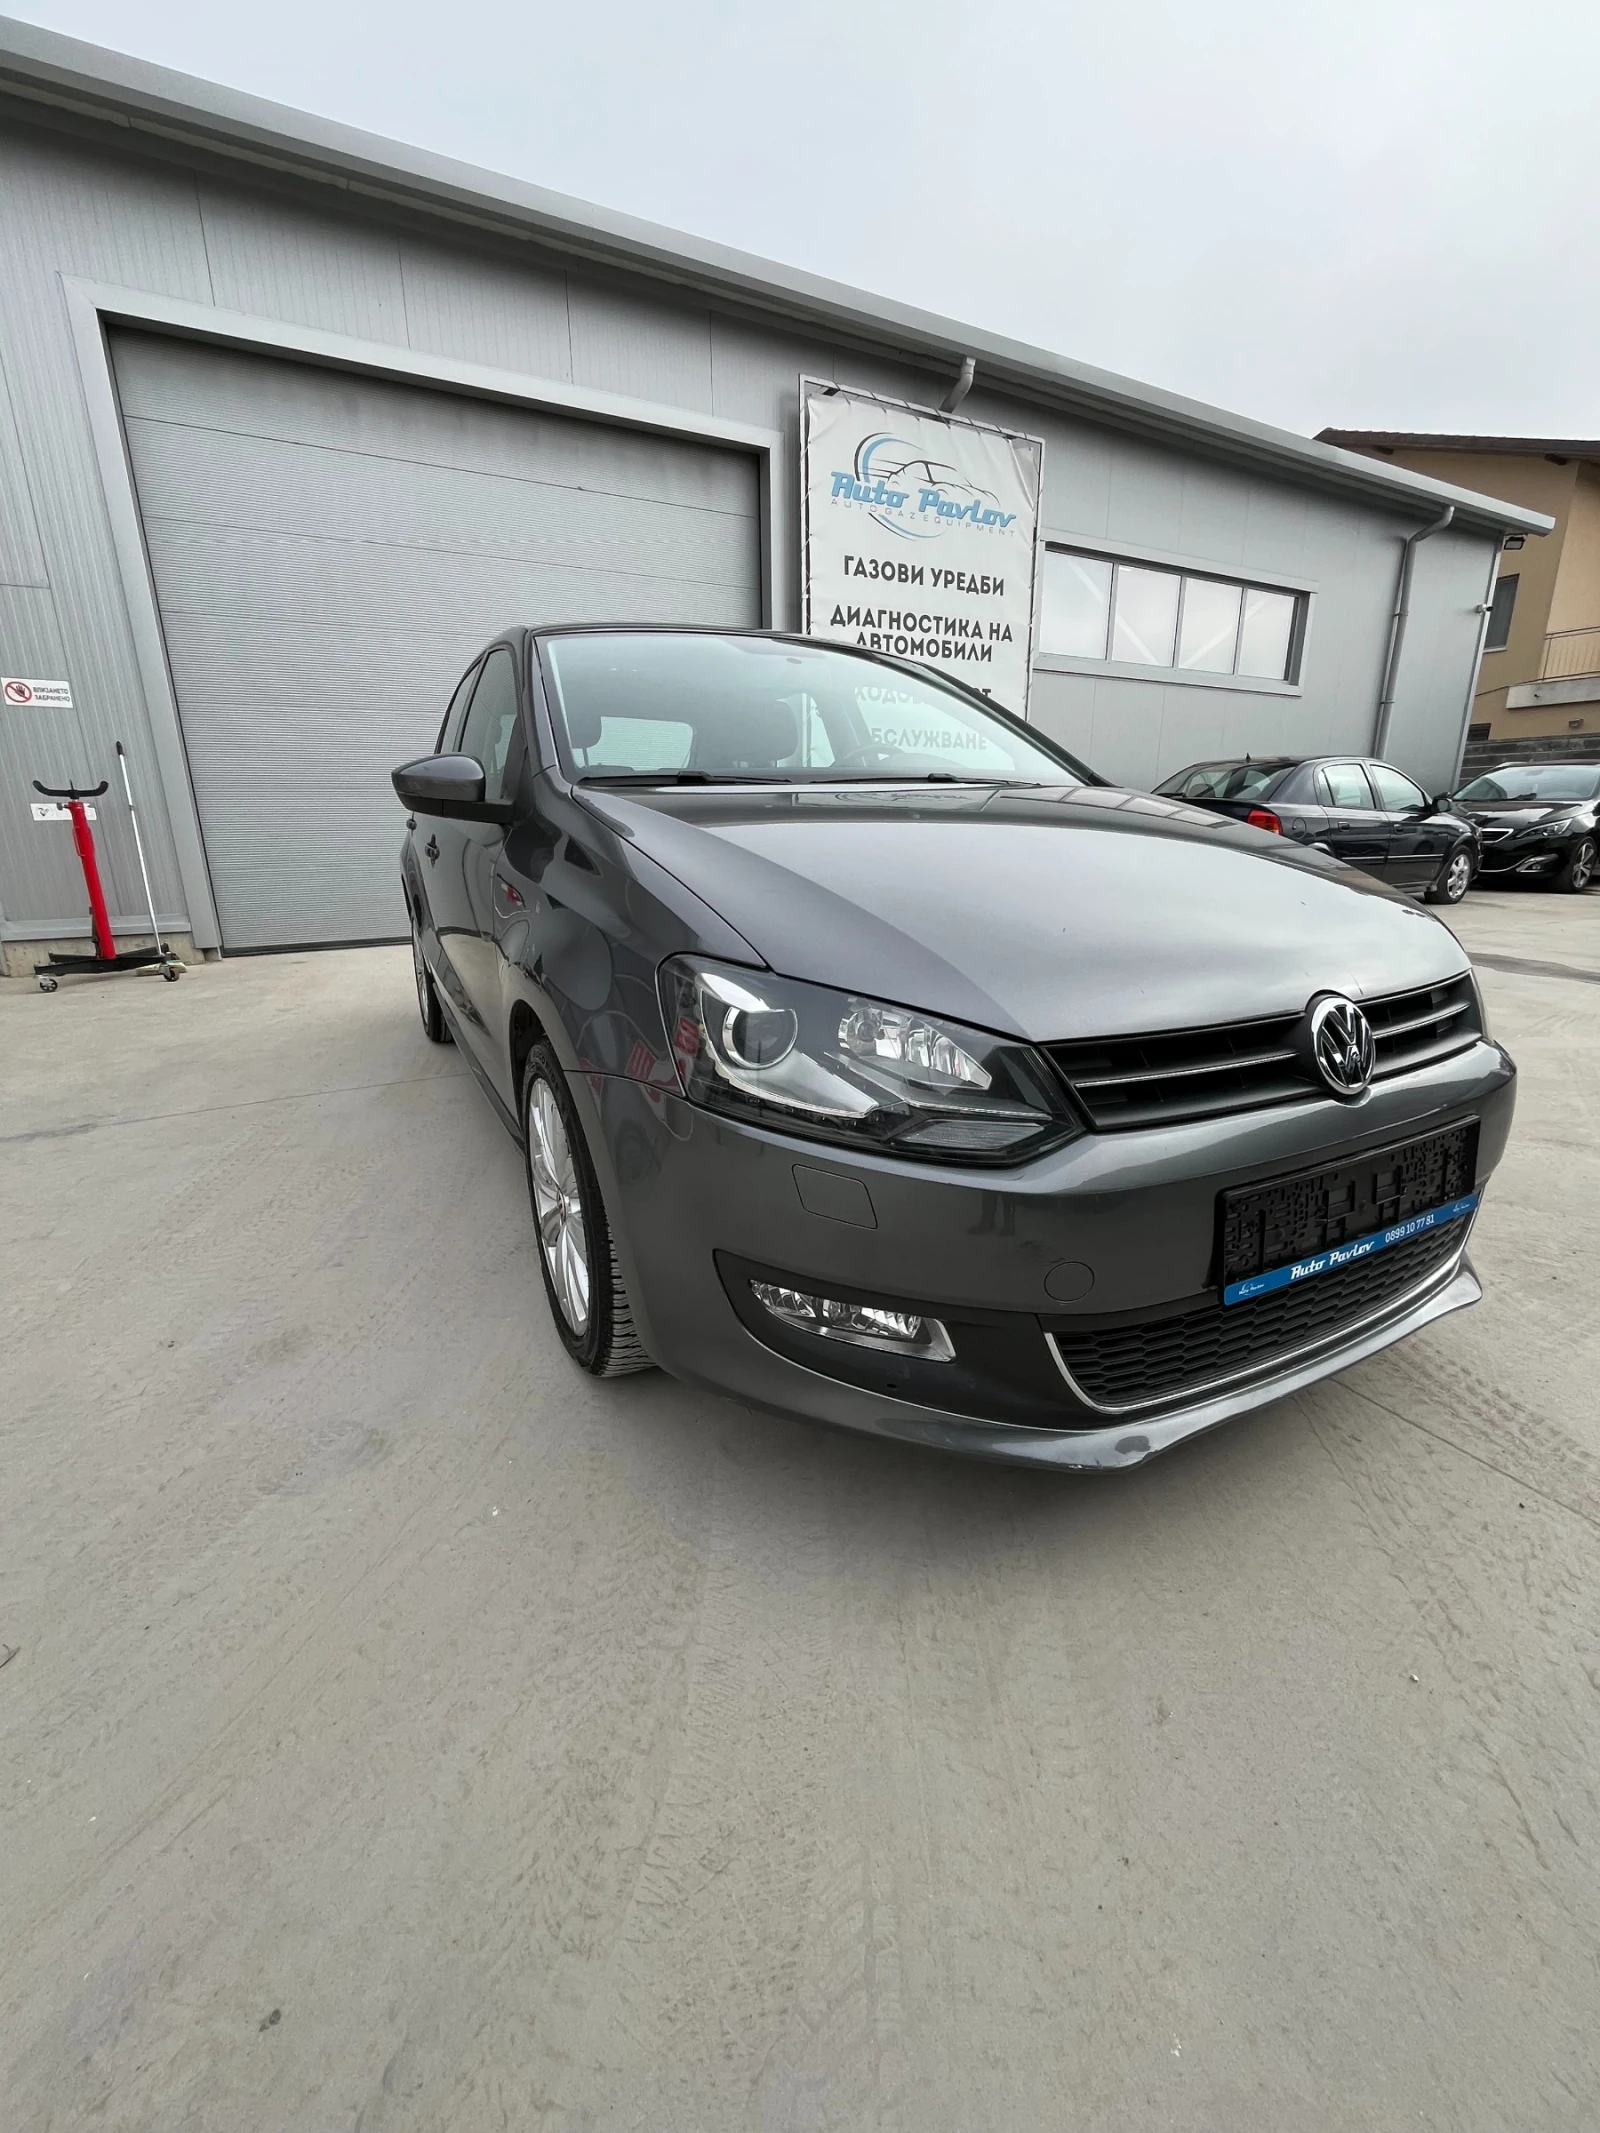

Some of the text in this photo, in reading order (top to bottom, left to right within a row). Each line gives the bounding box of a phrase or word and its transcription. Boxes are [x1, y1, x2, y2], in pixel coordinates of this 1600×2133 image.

[831, 471, 1016, 528] Auto Pavlov
[844, 555, 1004, 596] ГАЗОВИ УРЕДБИ
[830, 604, 1013, 642] ДИАГНОСТИКА НА
[857, 632, 992, 662] АВТОМОБИЛИ
[871, 727, 987, 750] БСЛУЖВАНЕ
[1290, 1213, 1435, 1280] Auto Pavlov 0899 10 77 81
